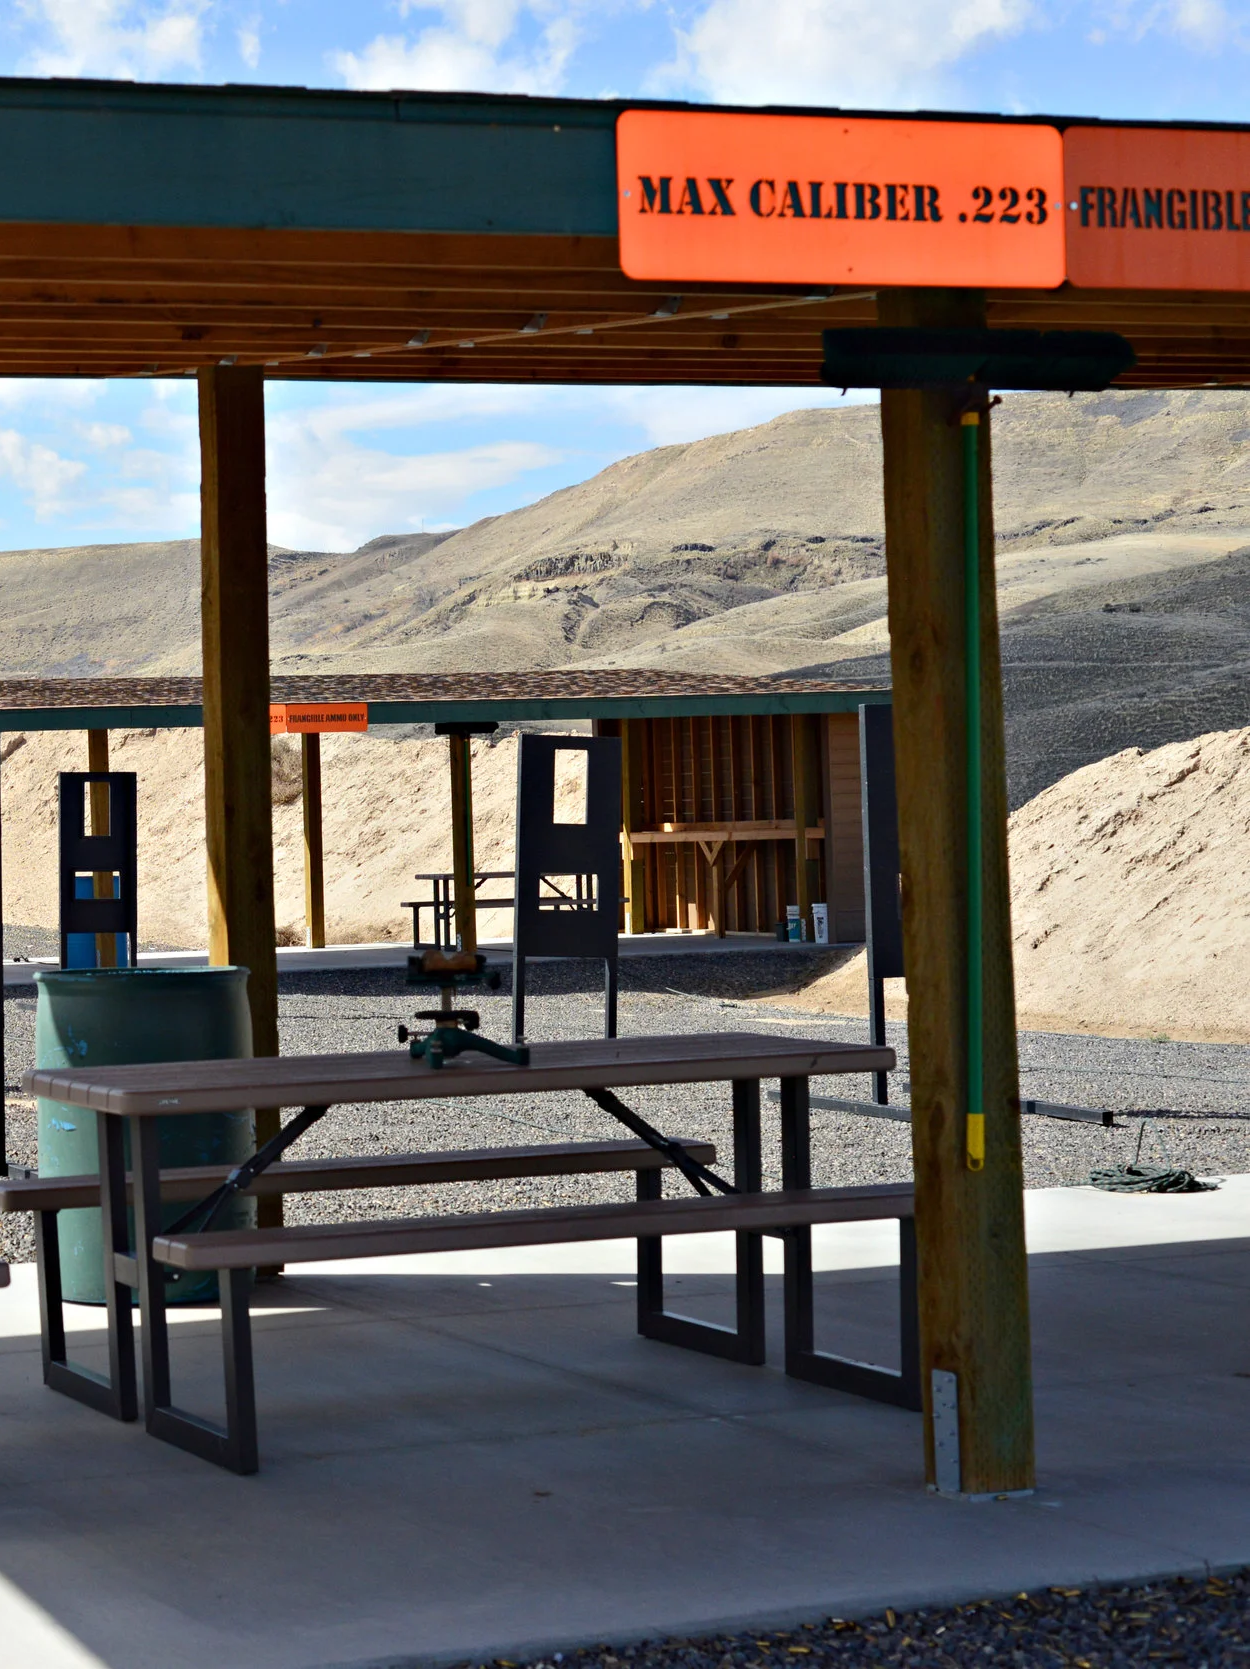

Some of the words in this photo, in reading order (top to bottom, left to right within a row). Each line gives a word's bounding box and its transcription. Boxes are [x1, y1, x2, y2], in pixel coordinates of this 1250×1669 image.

[638, 176, 735, 216] MAX
[749, 180, 943, 222] CALIBER
[958, 187, 1048, 225] .223
[289, 713, 325, 723] FRANGIBLE
[325, 713, 347, 722] AMMO
[348, 712, 365, 722] ONLY
